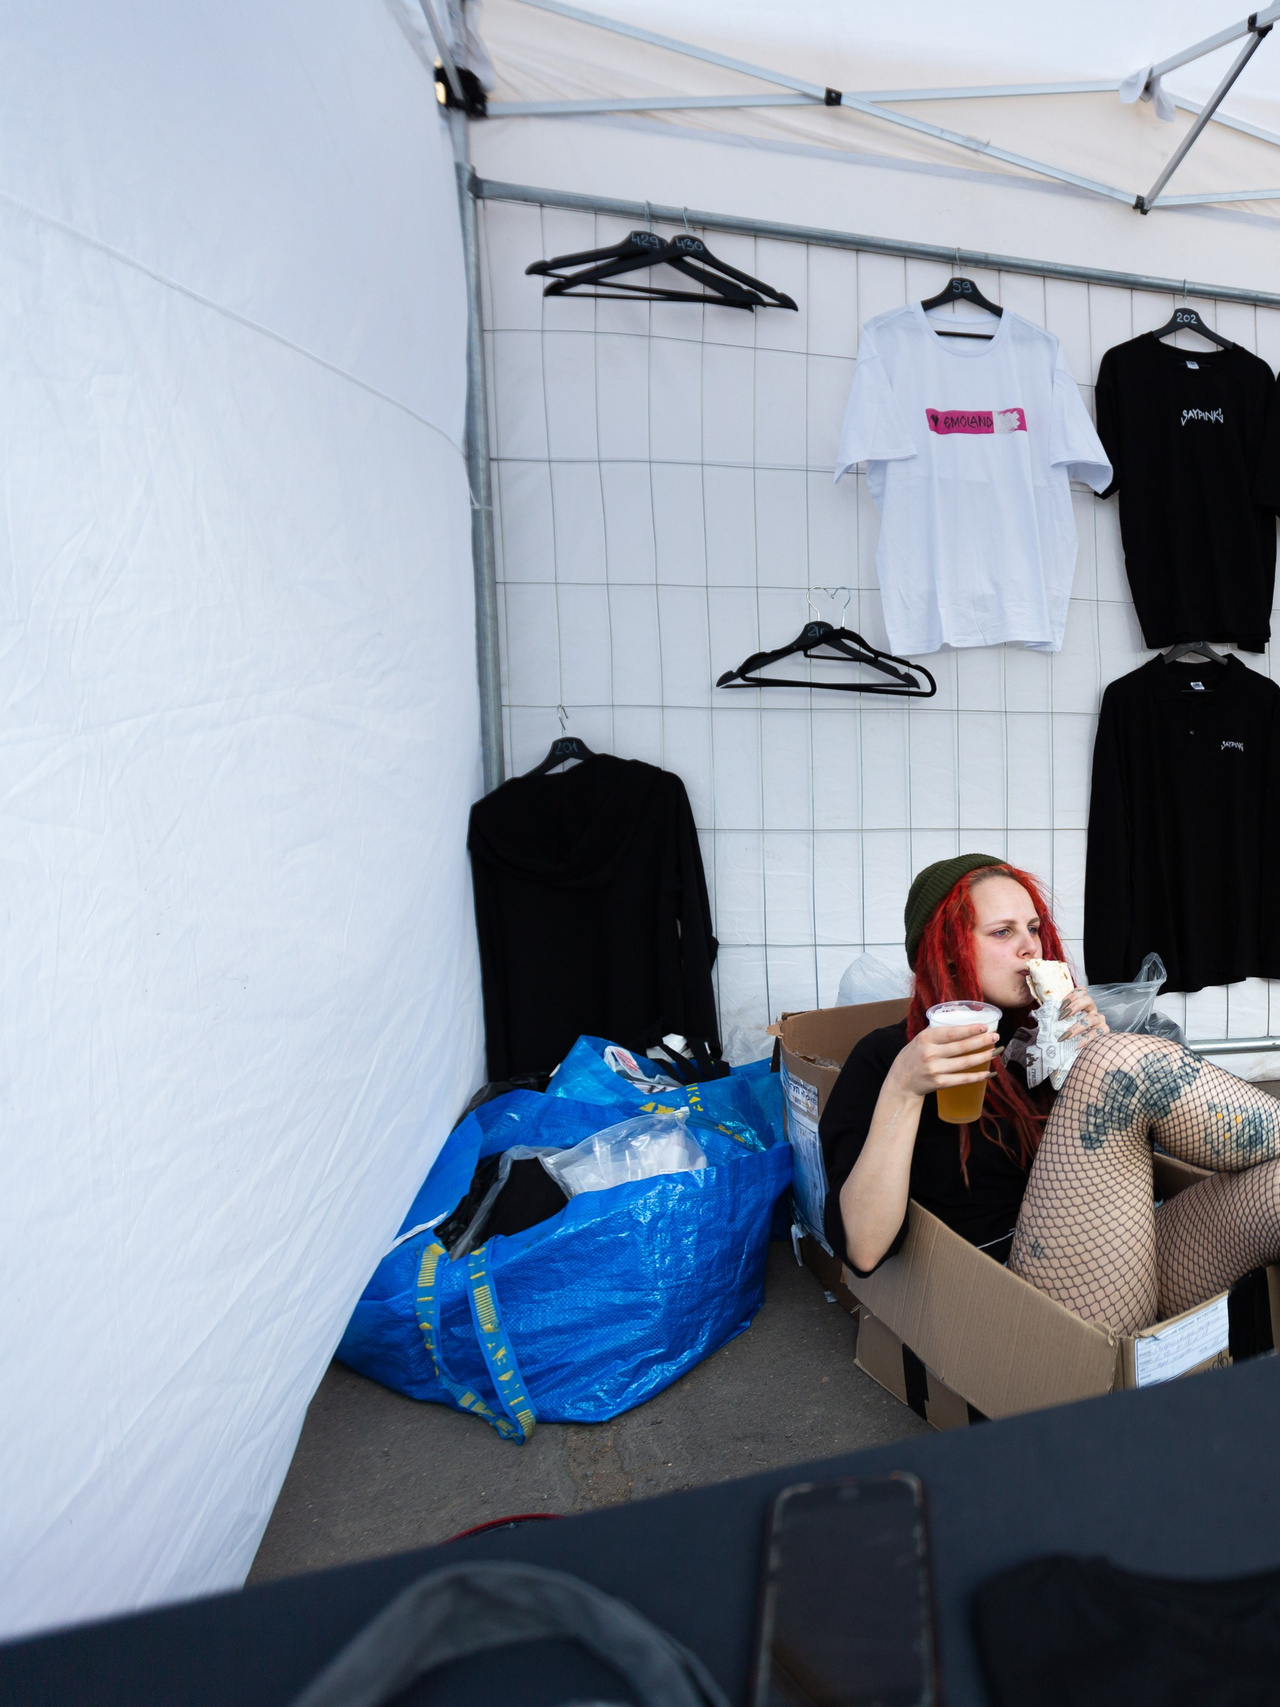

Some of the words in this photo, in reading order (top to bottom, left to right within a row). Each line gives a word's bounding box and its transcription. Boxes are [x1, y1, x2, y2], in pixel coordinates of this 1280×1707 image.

[630, 232, 660, 249] 429
[675, 236, 704, 251] 430
[952, 279, 973, 294] 59
[1176, 312, 1198, 325] 202
